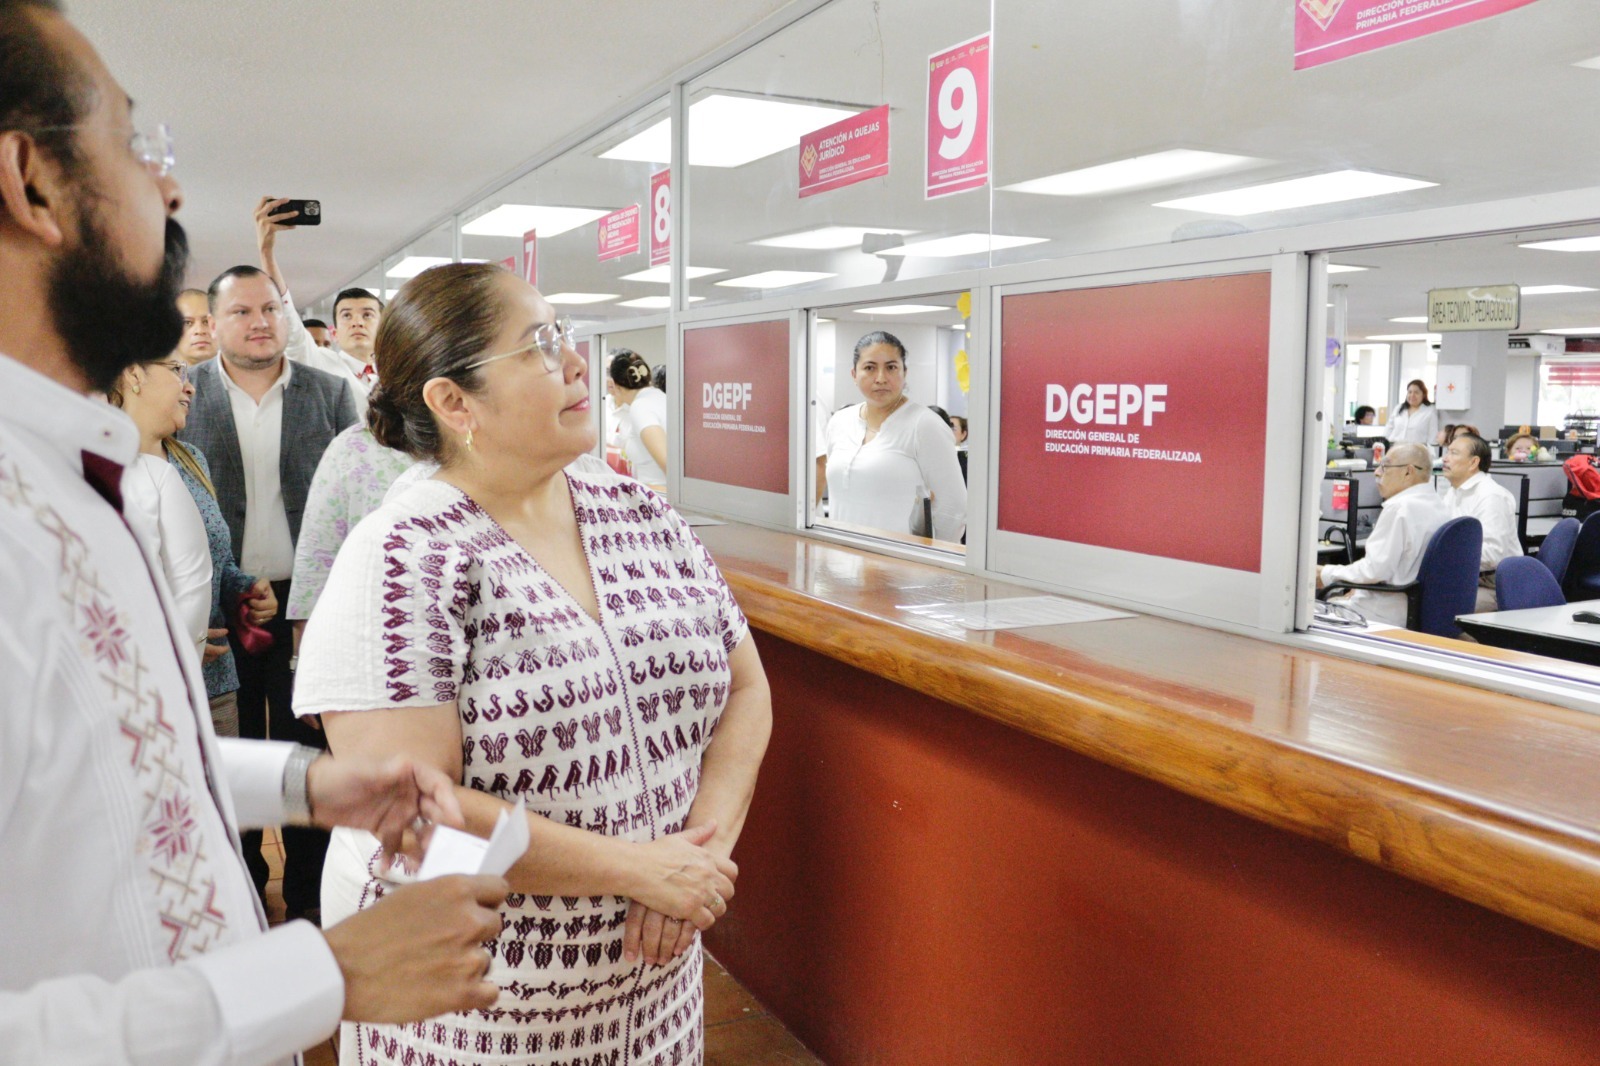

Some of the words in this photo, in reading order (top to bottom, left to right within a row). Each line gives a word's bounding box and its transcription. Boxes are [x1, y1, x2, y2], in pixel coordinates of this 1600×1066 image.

[1355, 11, 1398, 31] PRIMARIA
[937, 66, 978, 160] 9
[818, 131, 848, 150] ATENCIÓN
[848, 131, 854, 140] A
[854, 121, 880, 137] QUEJAS
[818, 145, 845, 162] JURÍDICO
[654, 183, 671, 243] 8
[525, 240, 535, 283] 7
[702, 382, 752, 410] DGEPF
[1045, 383, 1168, 426] DGEPF
[1045, 429, 1086, 441] DIRECCIÓN
[1088, 431, 1126, 443] GENERAL
[1127, 433, 1140, 444] DE
[1045, 442, 1090, 454] EDUCACIÓN
[1091, 445, 1131, 458] PRIMARIA
[1132, 449, 1202, 463] FEDERALIZADA
